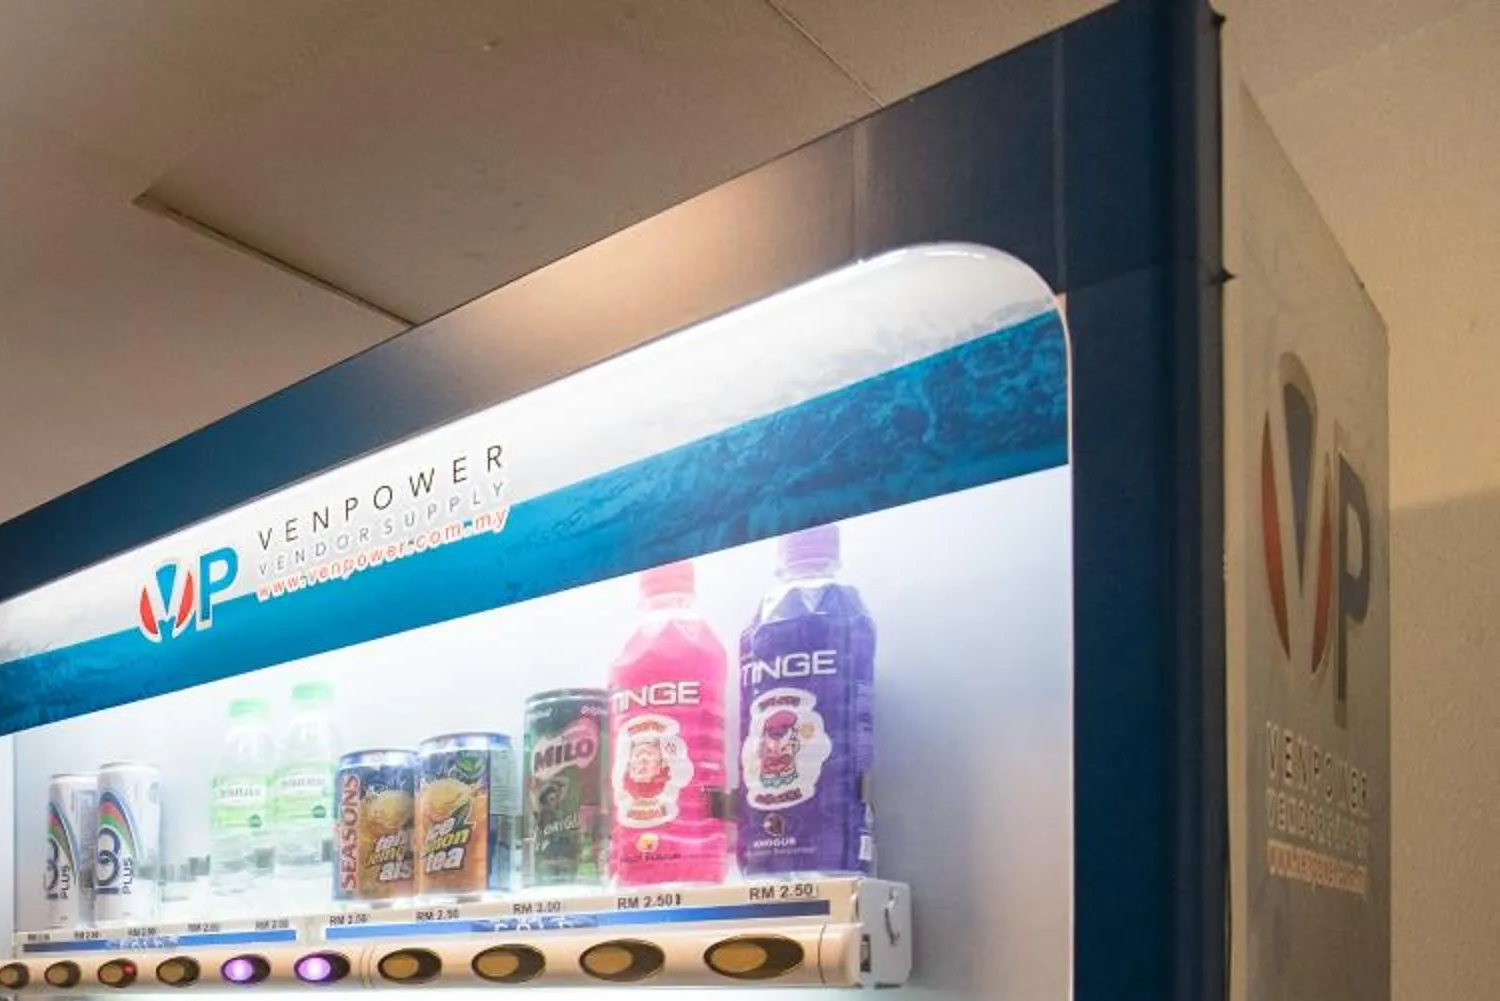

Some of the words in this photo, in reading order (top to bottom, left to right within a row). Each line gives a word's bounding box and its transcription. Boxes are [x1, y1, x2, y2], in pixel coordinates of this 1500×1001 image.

[258, 444, 503, 551] VENPOWER
[257, 508, 508, 598] www.venpower.com.my
[341, 774, 361, 891] SEASONS
[120, 857, 133, 895] PLUS
[750, 886, 775, 900] RM
[779, 883, 812, 898] 2.50
[513, 902, 533, 914] RM
[617, 896, 639, 910] RM
[643, 894, 673, 908] 2.50
